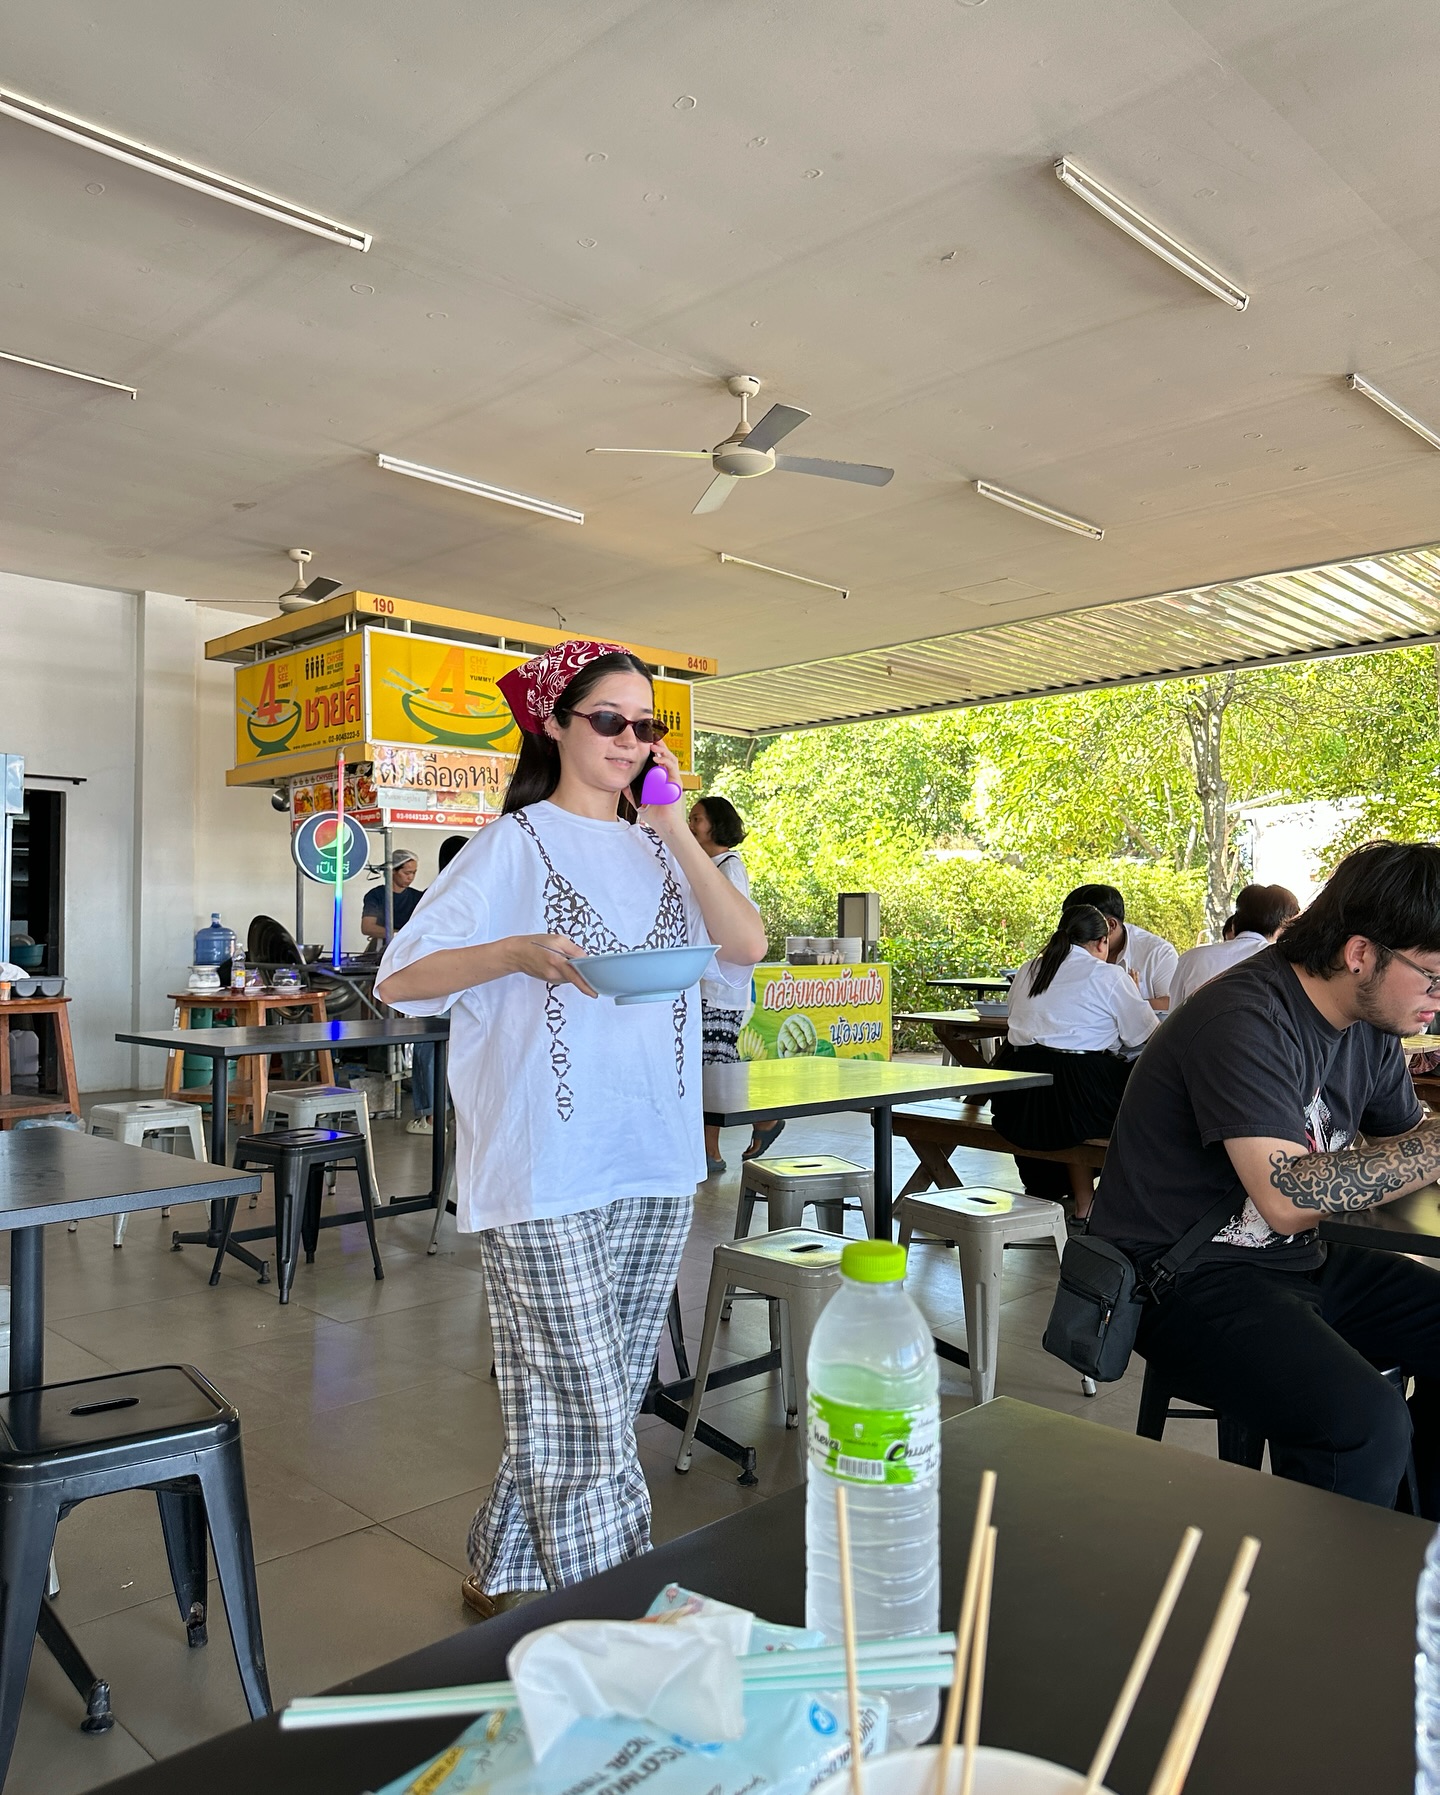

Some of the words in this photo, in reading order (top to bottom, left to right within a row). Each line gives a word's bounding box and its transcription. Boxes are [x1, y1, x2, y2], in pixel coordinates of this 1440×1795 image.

[373, 597, 394, 614] 190
[470, 656, 488, 665] CHY
[470, 665, 488, 675] SEE
[688, 657, 707, 671] 8410
[427, 647, 480, 715] 4
[257, 663, 282, 724] 4
[305, 664, 360, 732] ชายสี่
[829, 1016, 883, 1047] น้องราม
